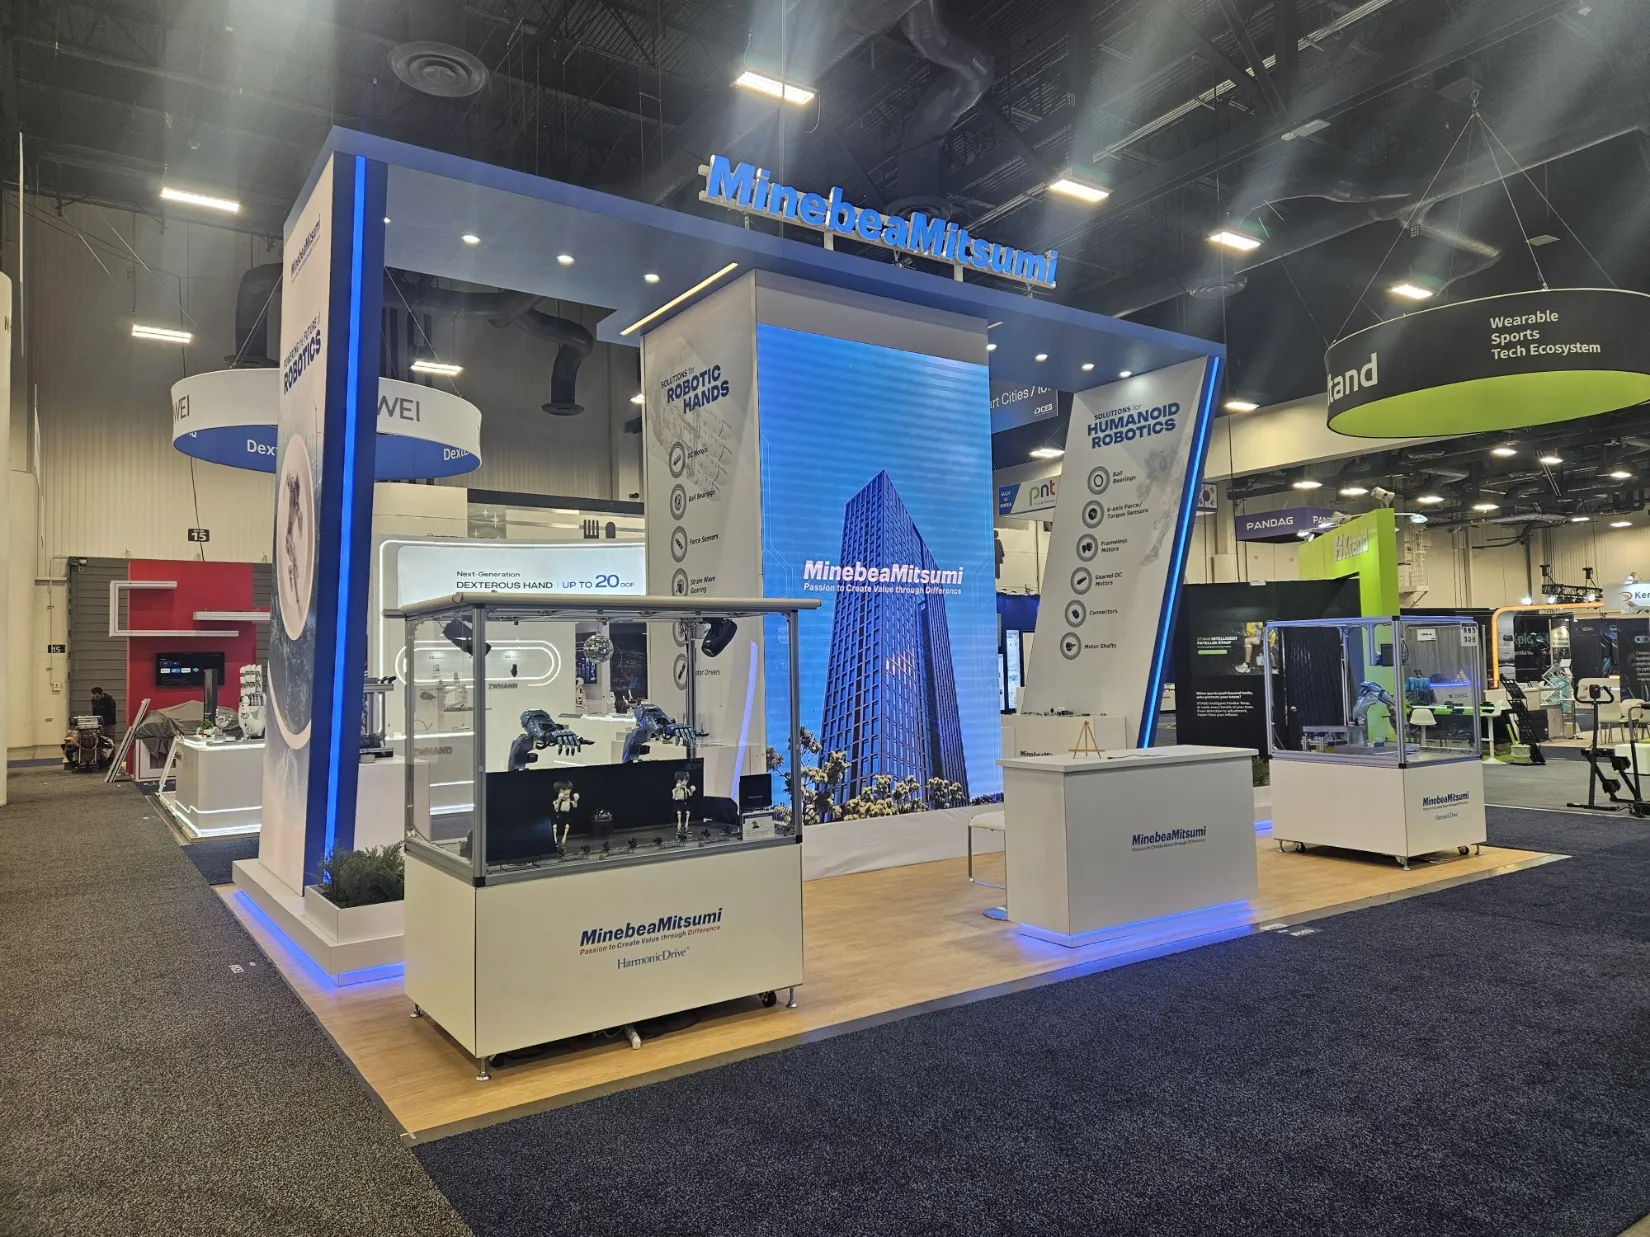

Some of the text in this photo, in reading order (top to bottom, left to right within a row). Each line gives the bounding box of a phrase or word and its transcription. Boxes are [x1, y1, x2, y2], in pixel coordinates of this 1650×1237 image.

[706, 154, 1059, 285] MinebeaMitsumi
[1490, 310, 1559, 328] Wearable
[1491, 328, 1540, 345] Sports
[1492, 342, 1600, 360] Tech Ecosystem
[284, 329, 321, 395] ROBOTICS
[661, 369, 688, 388] SOLUTIONS
[667, 364, 721, 404] ROBOTIC
[684, 380, 730, 414] HANDS
[1001, 389, 1029, 404] Cities
[1088, 402, 1180, 436] HUMANOID
[1094, 406, 1131, 420] SOLUTIONS
[1092, 418, 1176, 450] ROBOTICS
[246, 439, 278, 456] Dex
[1112, 476, 1136, 484] Bearings
[1246, 516, 1294, 530] PANDAG
[192, 532, 206, 541] 15
[690, 534, 718, 546] Force Sensors
[1100, 538, 1128, 546] Frameless
[595, 574, 619, 588] 20
[804, 560, 964, 585] MinebeaMitsumi
[804, 583, 834, 592] Passion
[874, 586, 894, 594] Value
[895, 586, 924, 596] through
[926, 586, 962, 595] Difference
[1423, 791, 1469, 806] MinebeaMitsumi
[1132, 826, 1206, 846] MinebeaMitsumi
[580, 908, 722, 947] MinebeaMitsumi
[580, 946, 607, 956] Passion
[617, 940, 640, 949] Create
[642, 936, 659, 945] Value
[661, 931, 686, 941] through
[688, 925, 720, 936] Difference
